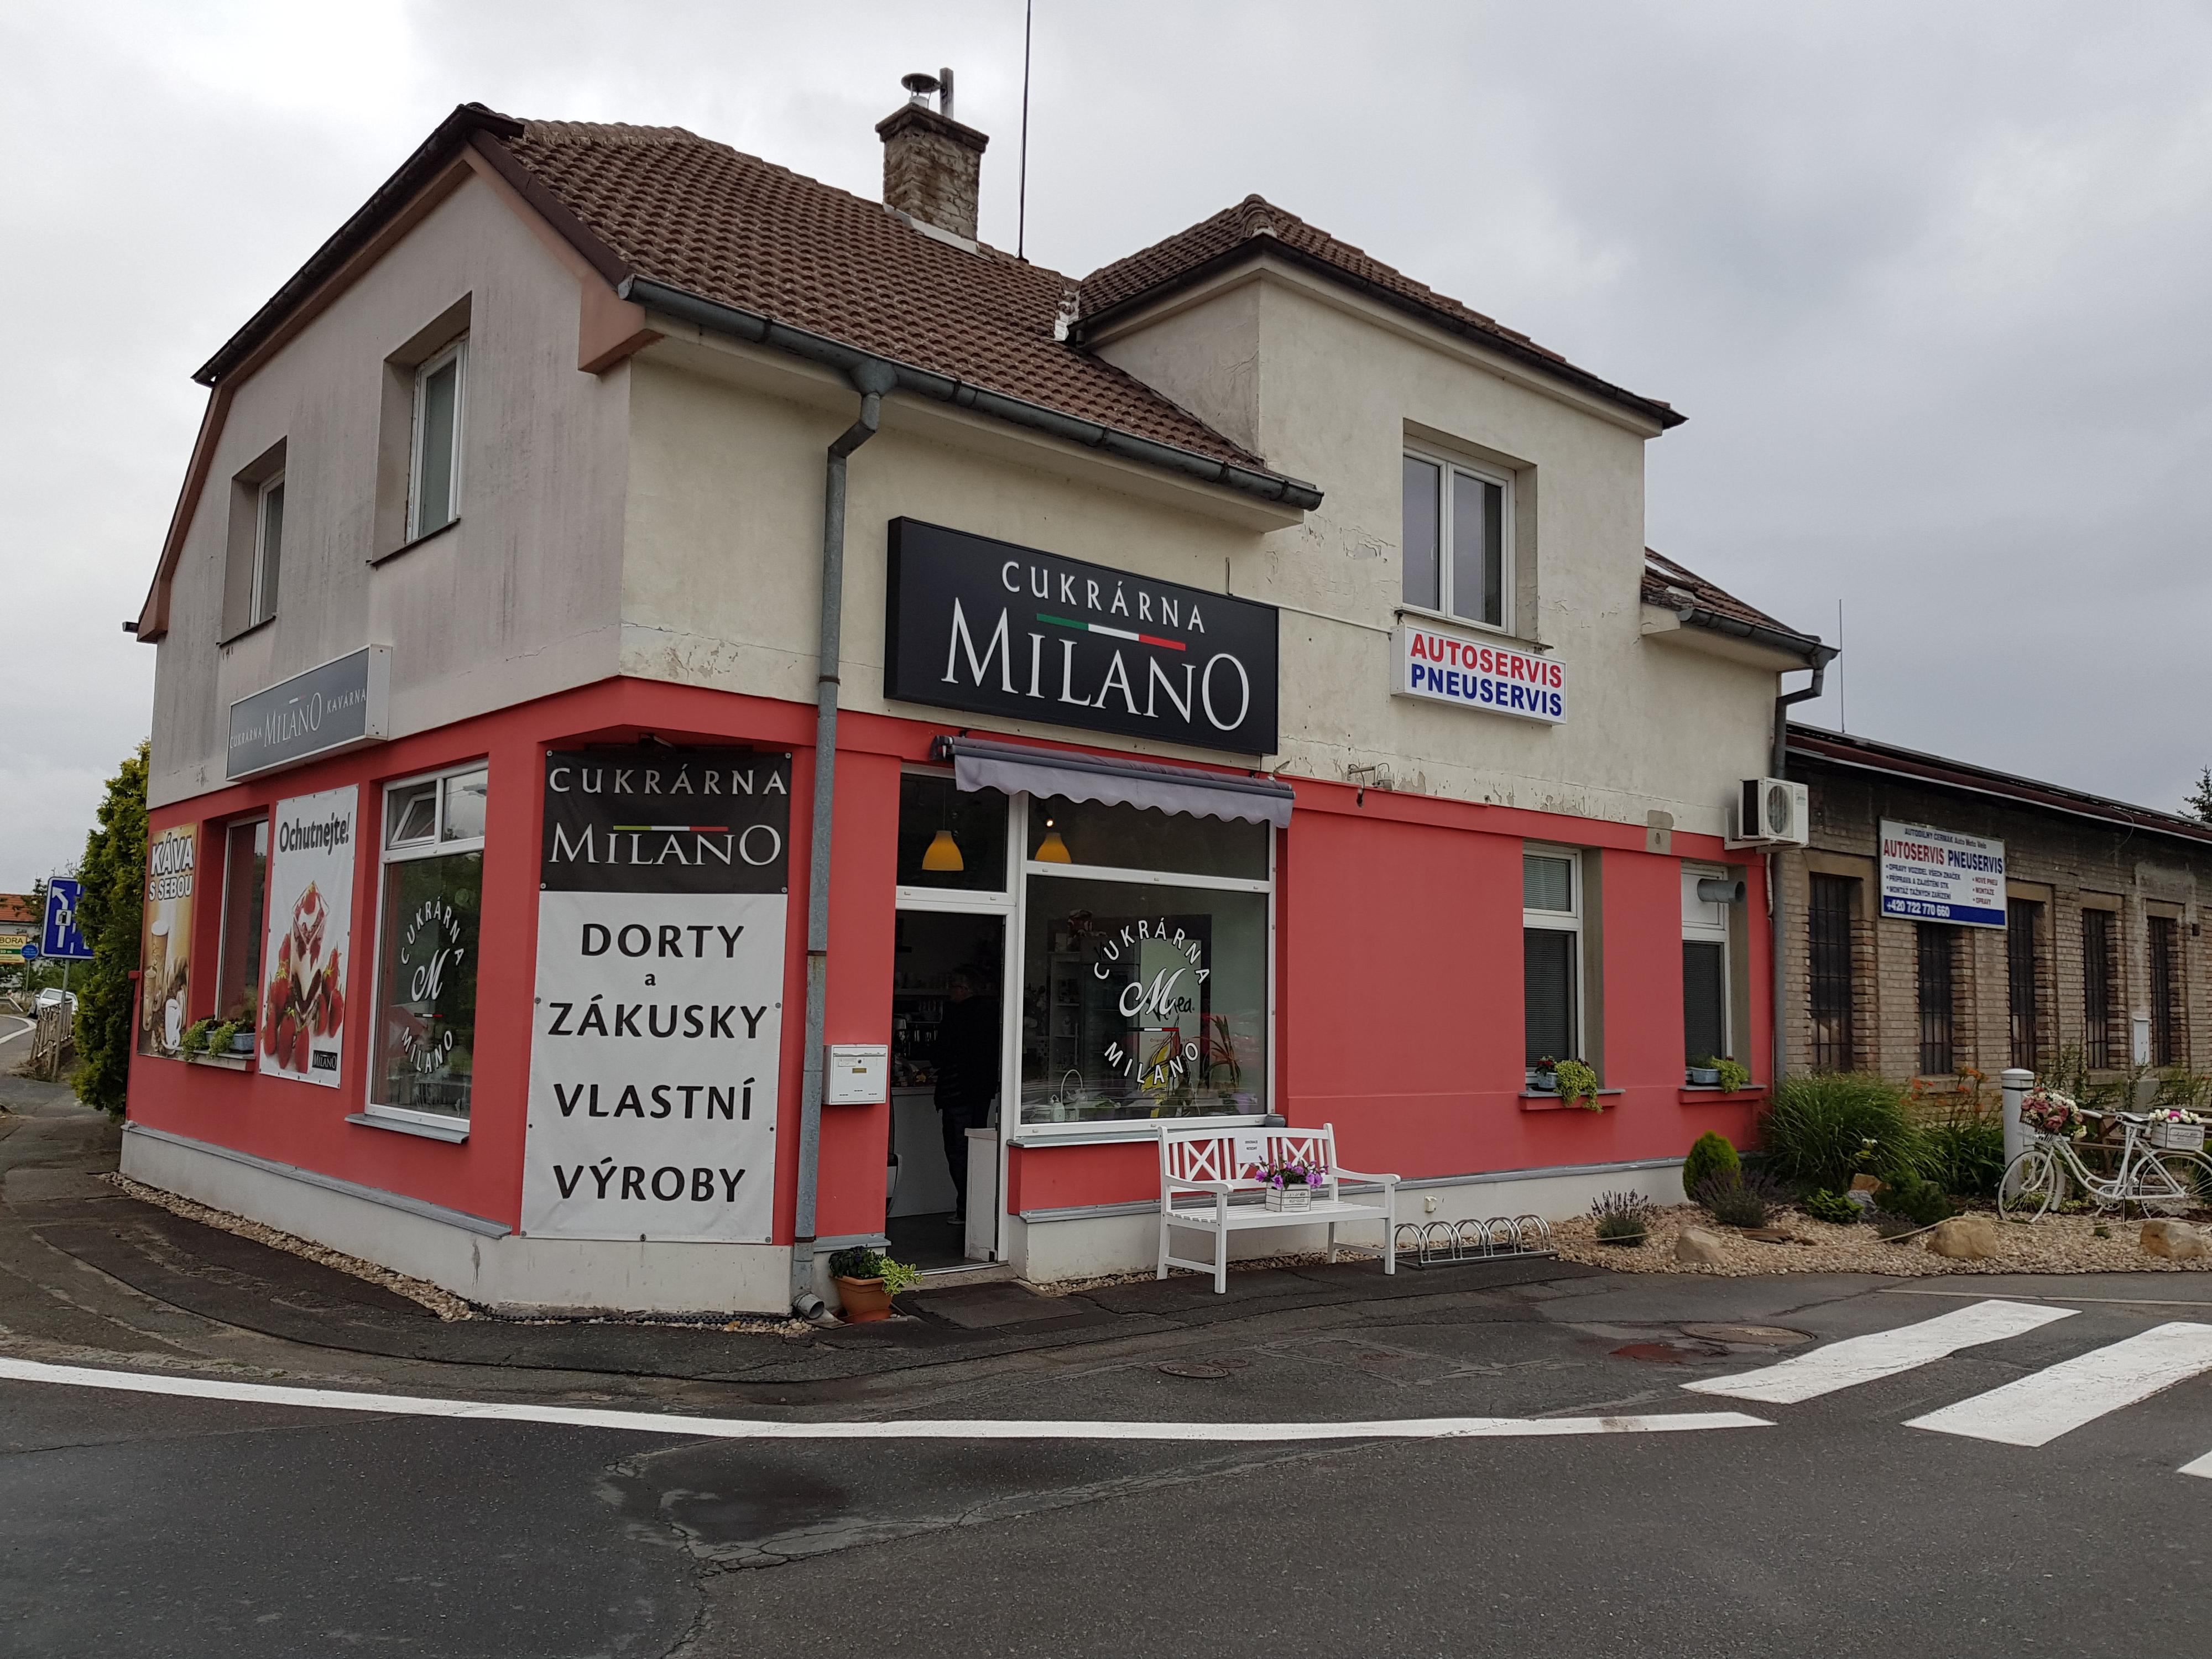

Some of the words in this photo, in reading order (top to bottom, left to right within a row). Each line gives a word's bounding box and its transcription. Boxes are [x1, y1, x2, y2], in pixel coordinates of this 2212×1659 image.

[1001, 561, 1205, 633] CUKRÁRNA
[941, 597, 1249, 731] MILANO
[1411, 634, 1562, 688] AUTOSERVIS
[1411, 664, 1562, 716] PNEUSERVIS
[264, 692, 322, 747] MILANO
[549, 764, 787, 795] CUKRÁRNA
[150, 832, 194, 877] KÁVA
[279, 812, 349, 855] Ochutnejte!
[548, 822, 781, 867] MILANO
[1884, 839, 1944, 865] AUTOSERVIS
[1948, 849, 2003, 874] PNEUSERVIS
[149, 881, 156, 901] S
[158, 874, 192, 900] SEBOU
[1887, 899, 1906, 912] +420
[1907, 901, 1921, 914] 722
[1922, 902, 1936, 916] 770
[401, 896, 465, 966] CUKRÁRNA
[581, 924, 744, 958] DORTY
[1094, 917, 1211, 985] CUKRÁRNA
[644, 973, 656, 987] a
[548, 994, 768, 1039] ZÁKUSKY
[314, 1053, 337, 1068] MILANO
[401, 1026, 453, 1074] MILANO
[1104, 1041, 1198, 1084] MILANO
[554, 1077, 755, 1120] VLASTNÍ
[553, 1157, 746, 1203] VÝROBY
